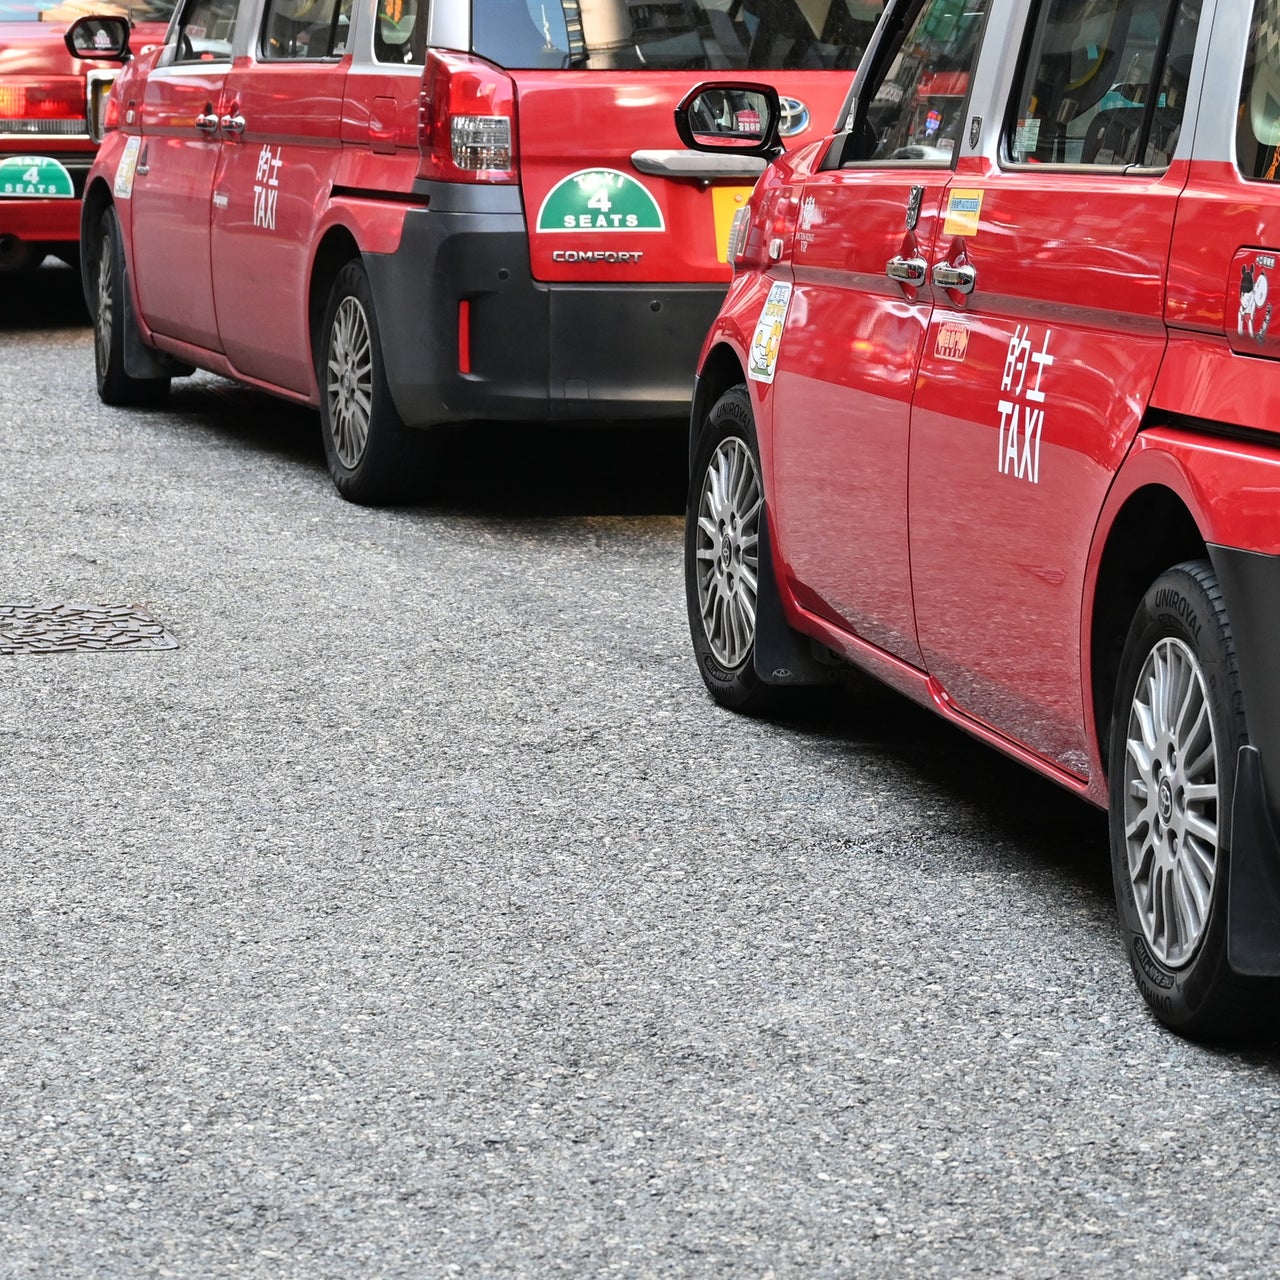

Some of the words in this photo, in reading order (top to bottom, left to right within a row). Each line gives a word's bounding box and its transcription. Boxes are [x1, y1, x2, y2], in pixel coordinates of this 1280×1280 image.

[22, 166, 40, 184] 4
[255, 143, 284, 187] 的士
[4, 183, 57, 194] SEATS
[587, 187, 613, 212] 4
[253, 184, 278, 231] TAXI
[563, 214, 639, 228] SEATS
[552, 250, 644, 264] COMFORT
[1000, 323, 1055, 403] 的士
[997, 399, 1045, 484] TAXI
[1154, 588, 1202, 639] UNIROYAL
